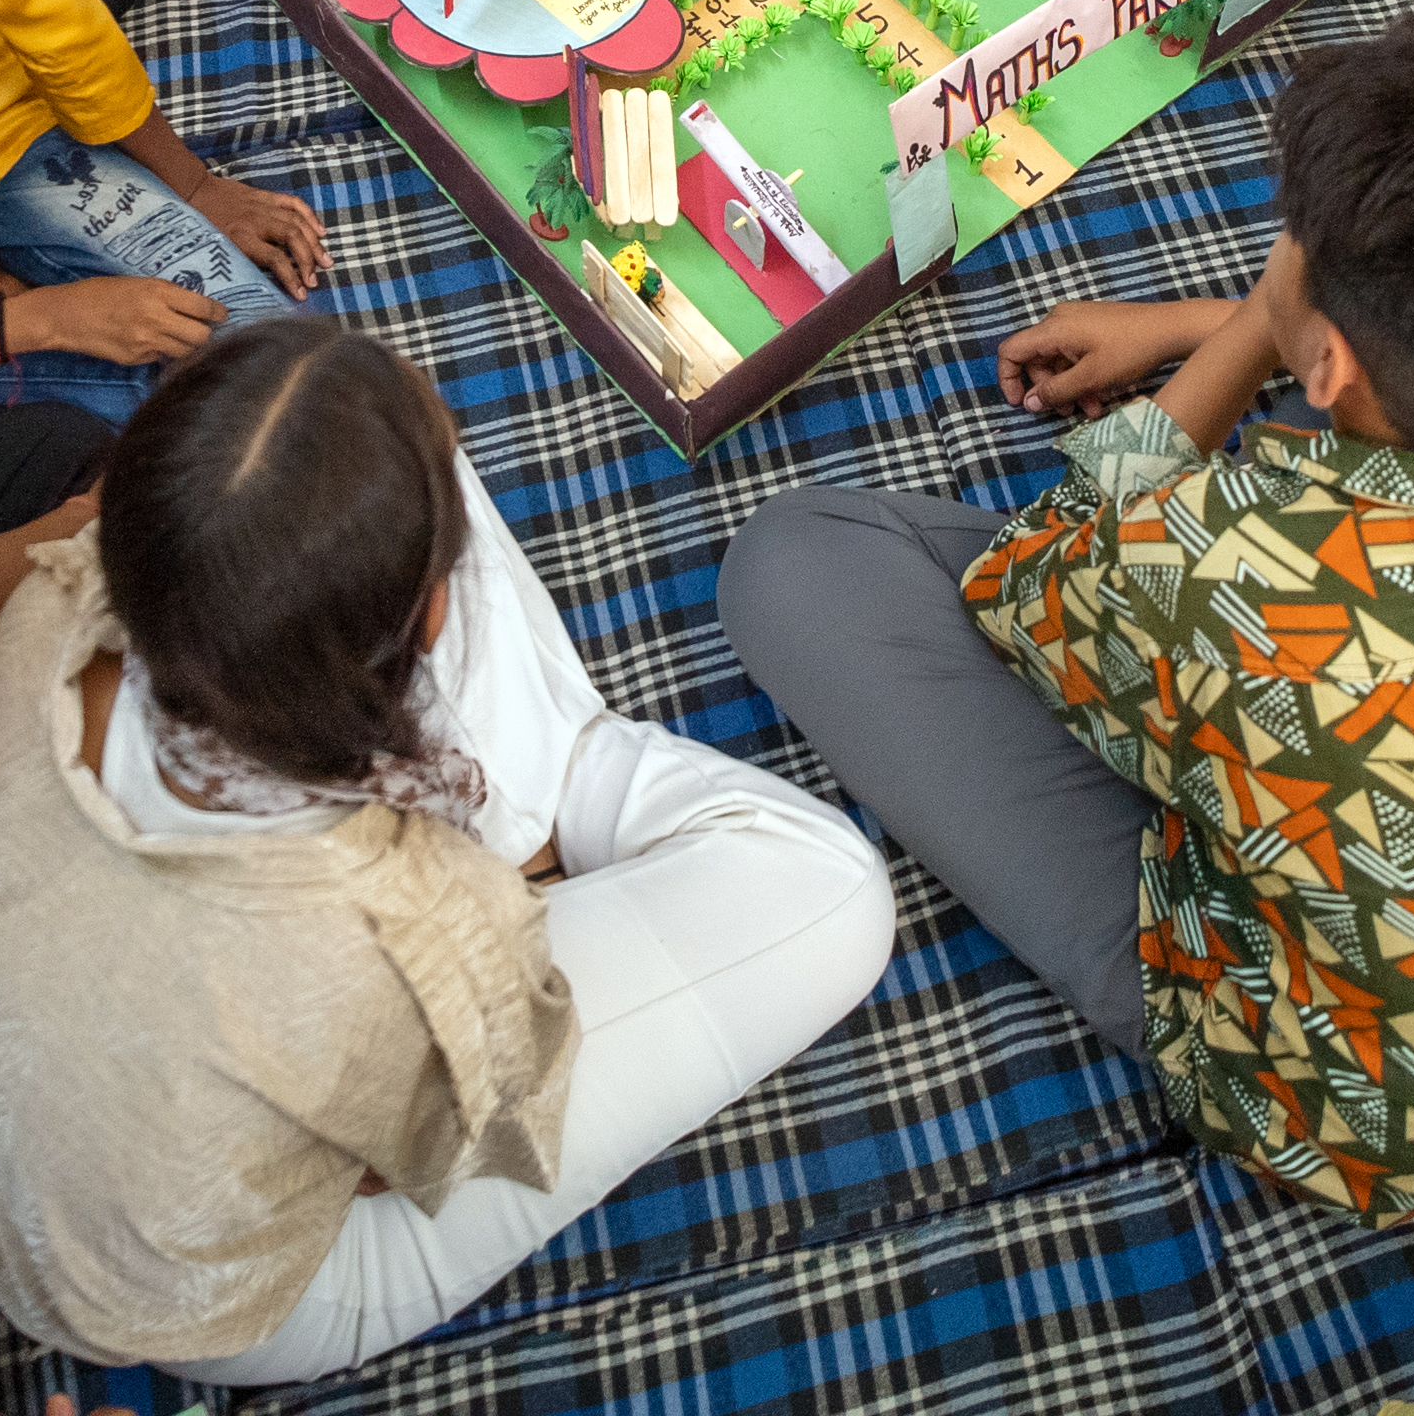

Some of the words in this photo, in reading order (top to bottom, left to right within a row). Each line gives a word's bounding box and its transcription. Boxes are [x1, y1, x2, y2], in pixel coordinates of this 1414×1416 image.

[600, 2, 610, 11] of
[855, 2, 889, 36] 5
[897, 41, 924, 67] 4
[938, 18, 1085, 150] MATHS
[1014, 159, 1044, 187] 1
